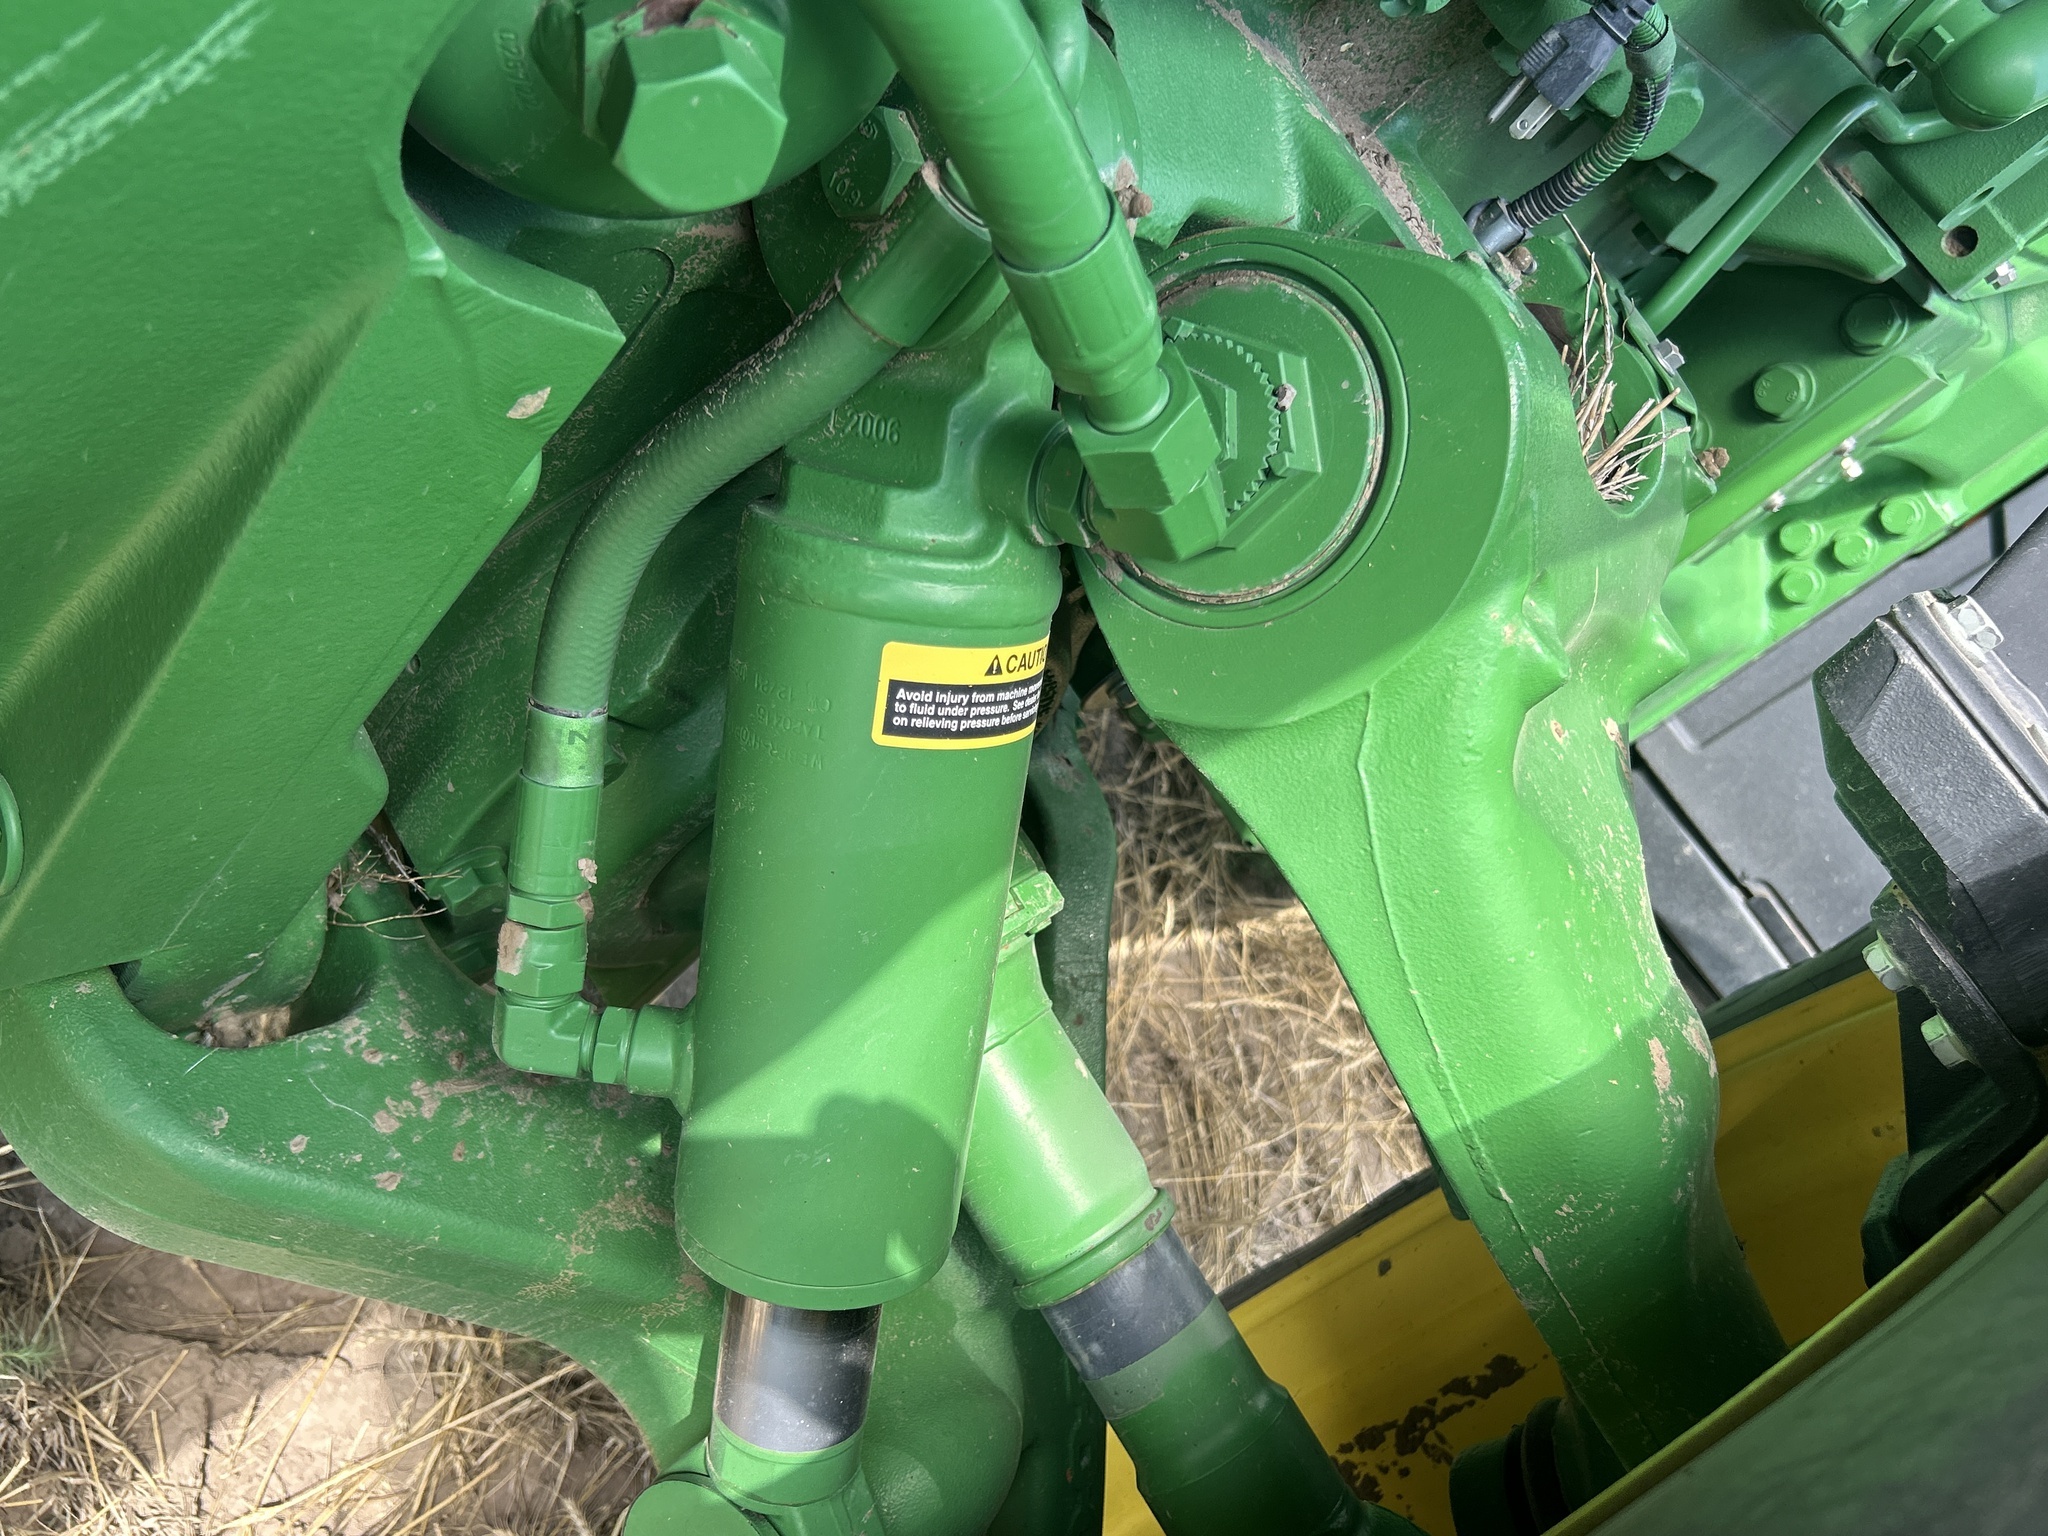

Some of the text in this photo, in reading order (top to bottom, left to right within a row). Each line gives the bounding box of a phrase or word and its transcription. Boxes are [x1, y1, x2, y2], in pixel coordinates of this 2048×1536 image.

[846, 409, 901, 445] 2006
[895, 688, 933, 702] Avoid
[935, 690, 970, 706] injury
[971, 692, 995, 704] from
[996, 687, 1028, 702] machine
[894, 701, 907, 713] to
[909, 703, 936, 716] fluid
[937, 705, 969, 717] under
[969, 704, 1010, 718] pressure.
[1012, 699, 1025, 711] See
[892, 716, 908, 727] on
[910, 716, 959, 732] relieving
[959, 717, 1000, 731] pressure
[1001, 713, 1022, 725] before
